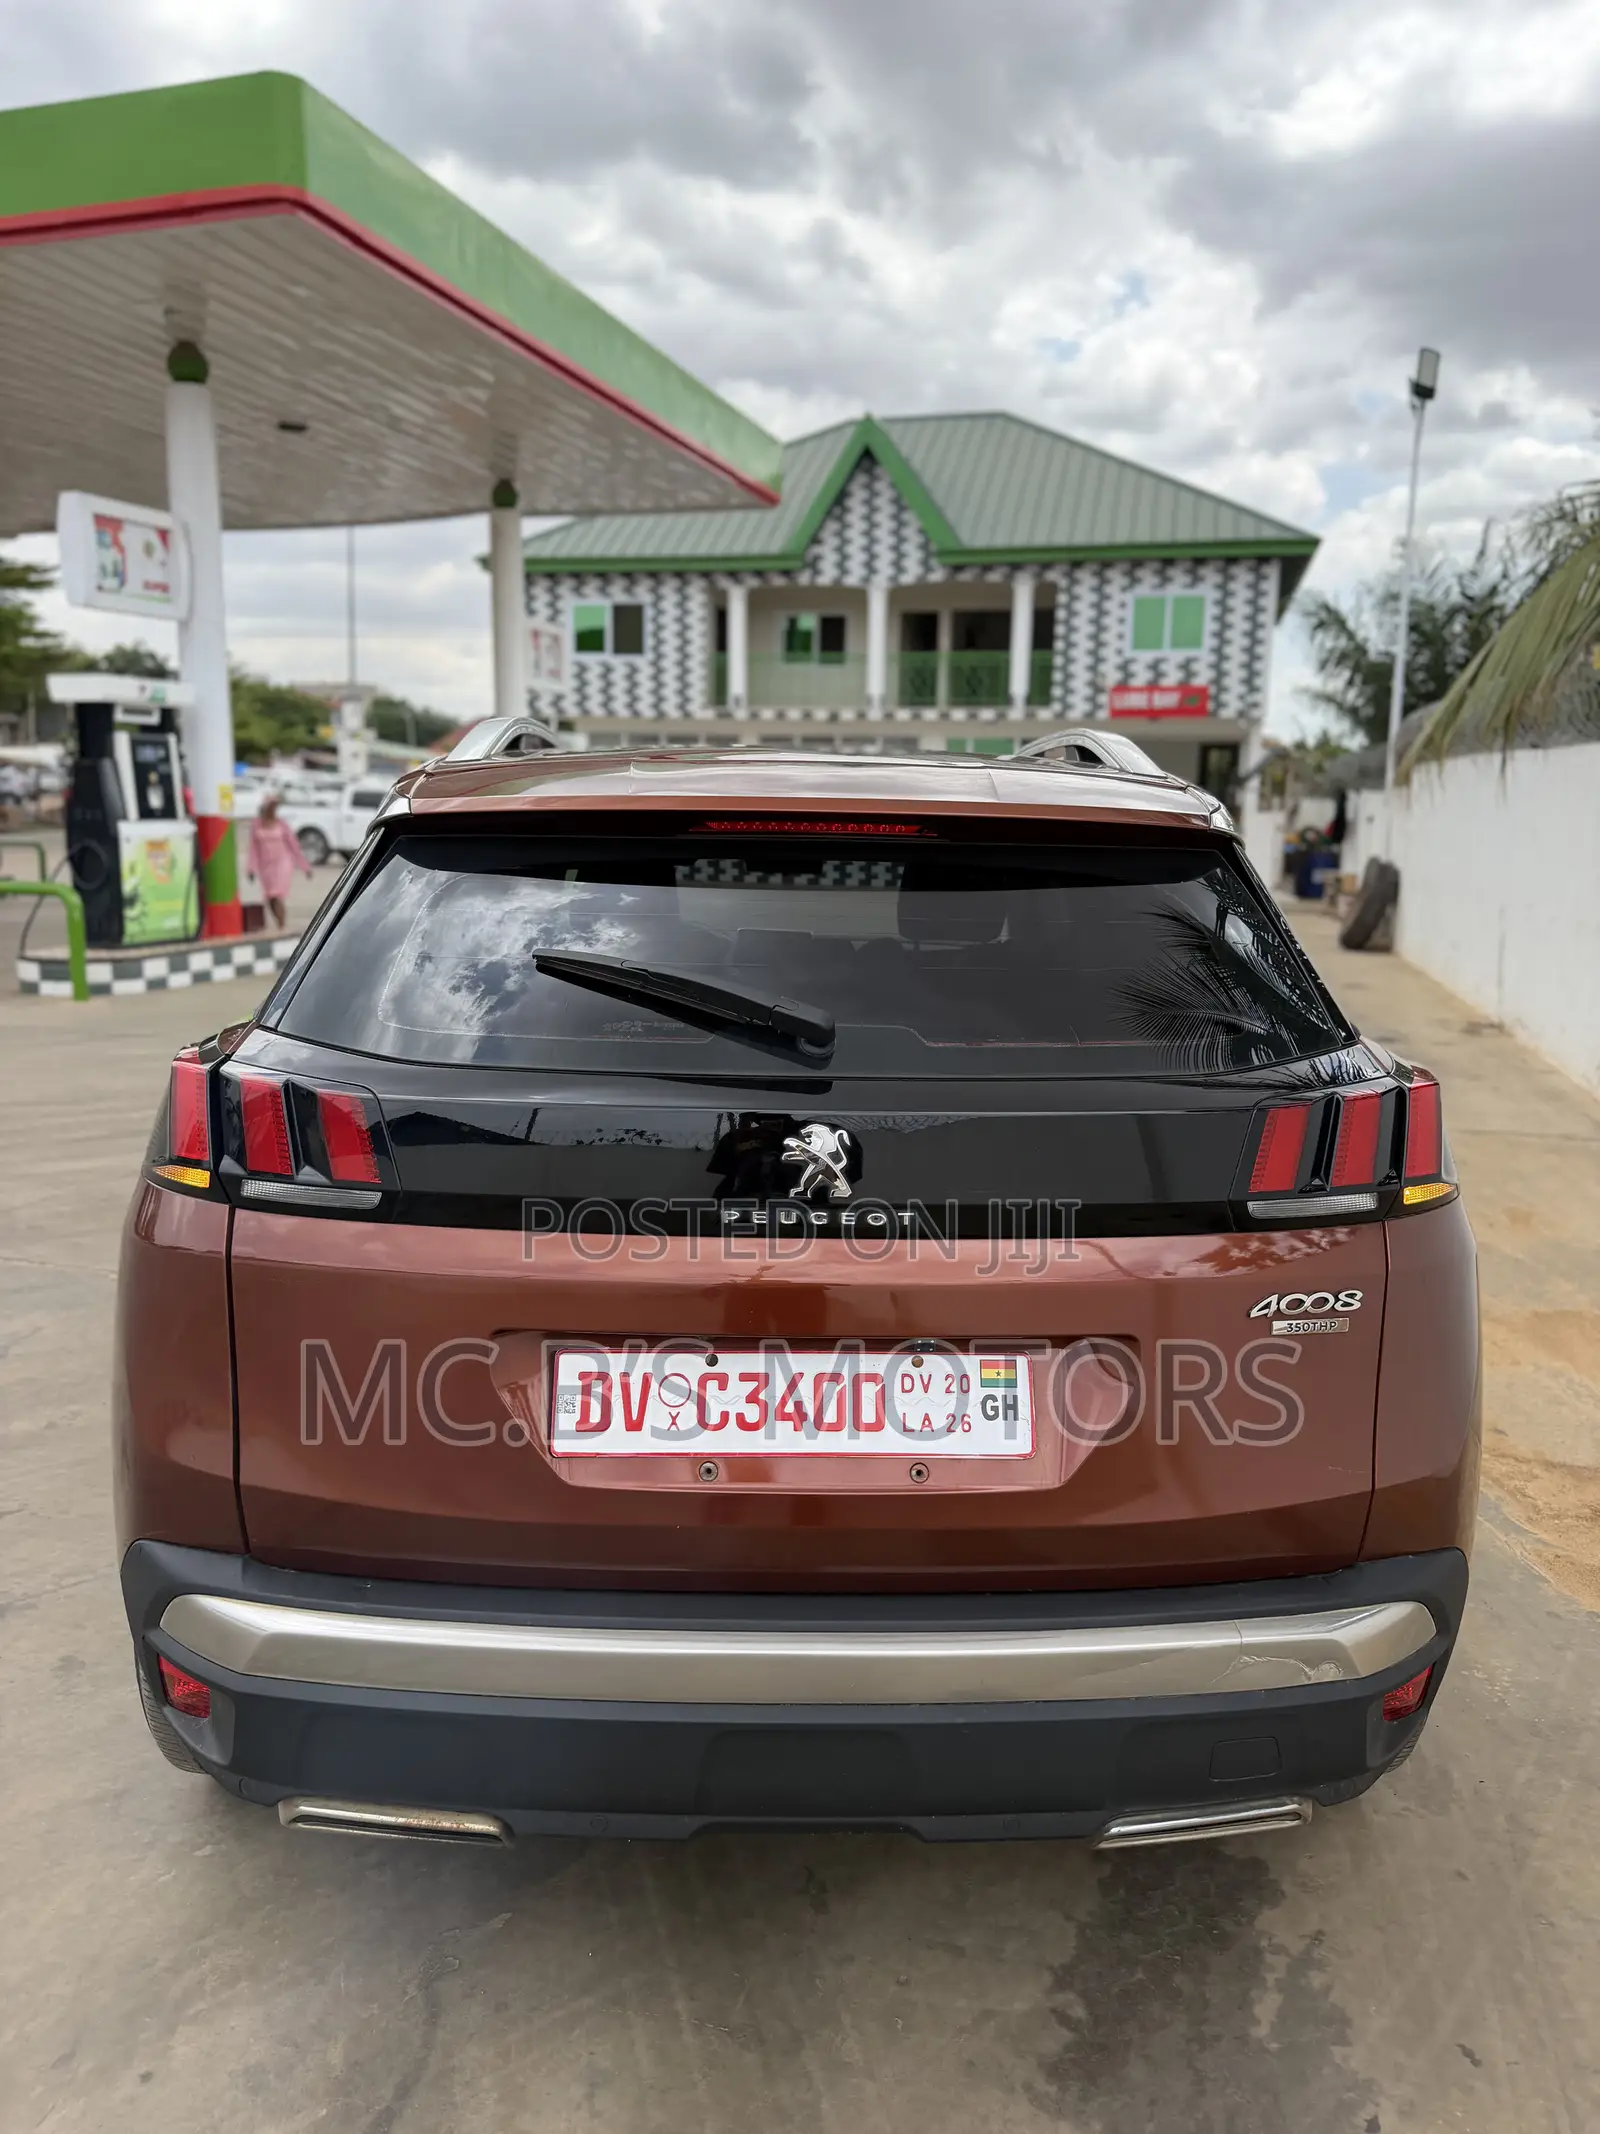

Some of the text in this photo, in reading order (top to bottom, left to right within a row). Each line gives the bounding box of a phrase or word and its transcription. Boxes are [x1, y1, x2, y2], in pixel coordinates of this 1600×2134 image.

[723, 1210, 915, 1226] PEUGEOT
[1249, 1289, 1364, 1319] 4008
[1286, 1320, 1339, 1334] 350THP
[901, 1373, 971, 1394] DV 20
[575, 1371, 654, 1433] DV
[981, 1393, 1020, 1422] GH
[902, 1412, 972, 1433] LA 26
